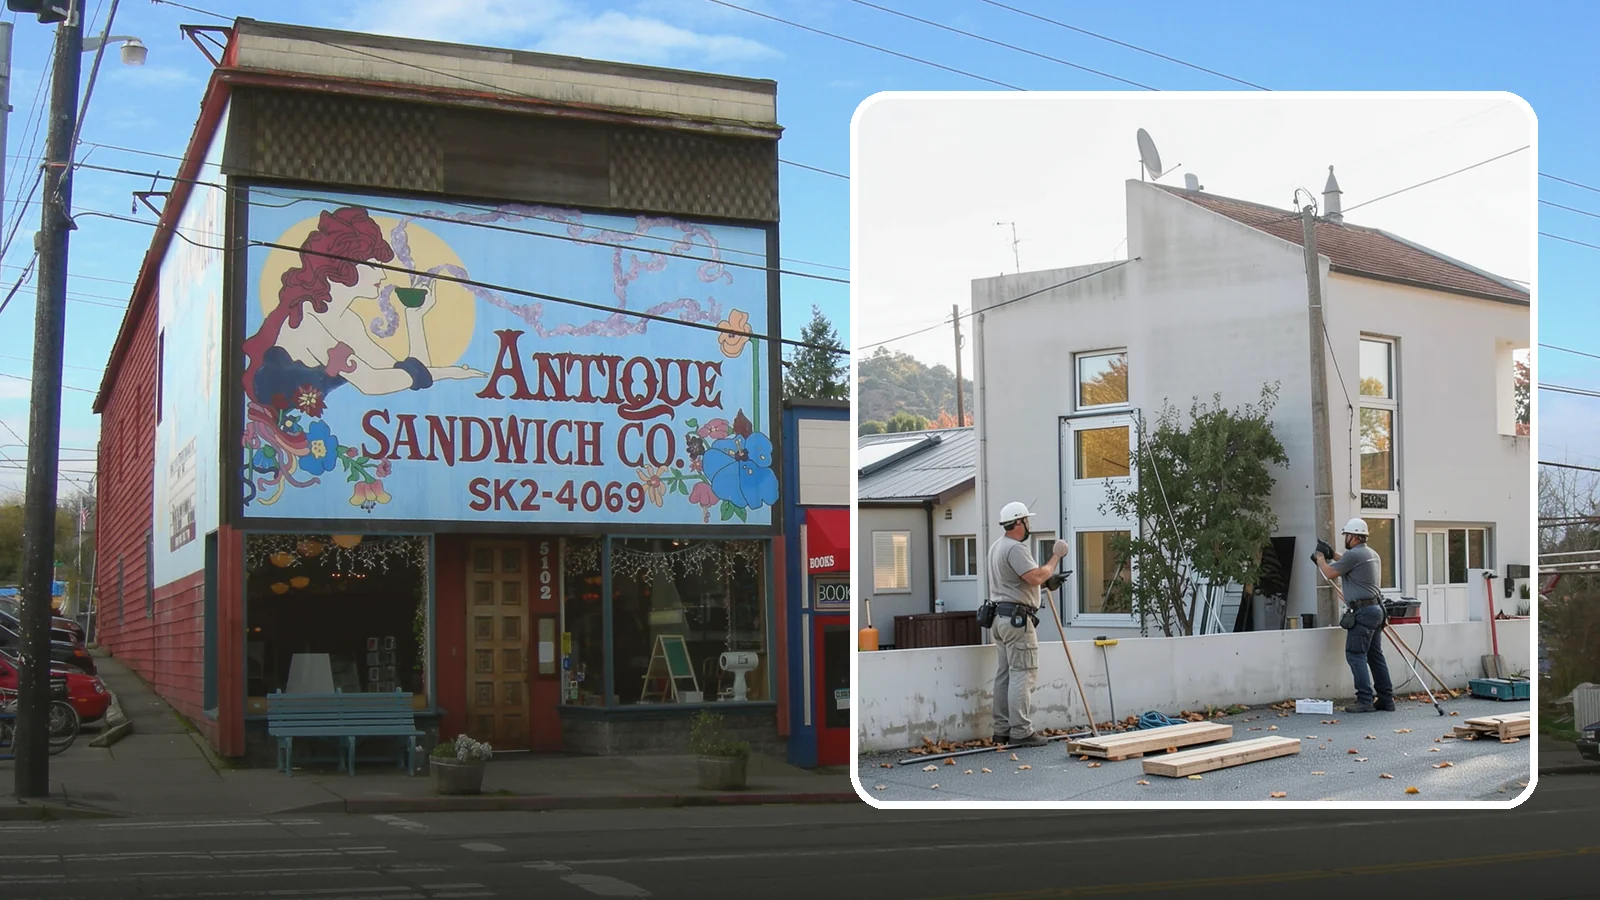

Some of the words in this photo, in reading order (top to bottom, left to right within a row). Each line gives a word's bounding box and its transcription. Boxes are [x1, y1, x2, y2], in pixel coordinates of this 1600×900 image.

[476, 329, 723, 420] ANTIQUE
[360, 408, 605, 467] SANDWICH
[616, 422, 685, 469] CO.
[469, 477, 646, 513] SK2-4069
[540, 542, 551, 599] 5102
[809, 555, 834, 569] BOOKS
